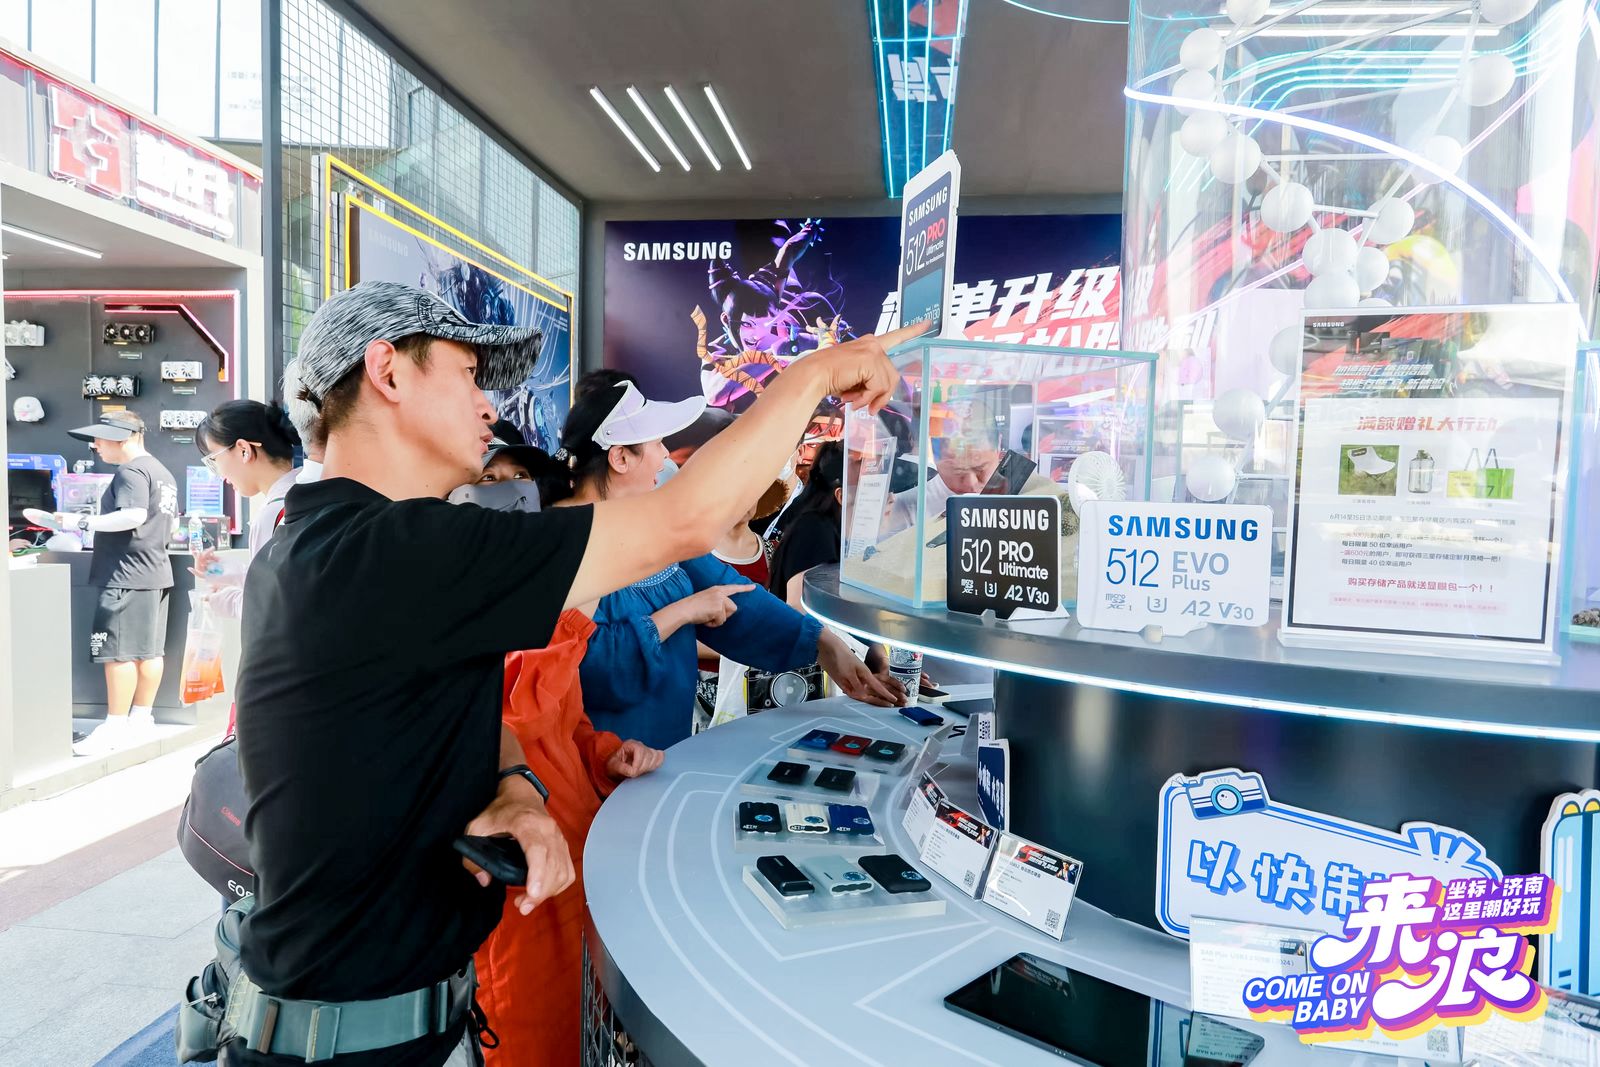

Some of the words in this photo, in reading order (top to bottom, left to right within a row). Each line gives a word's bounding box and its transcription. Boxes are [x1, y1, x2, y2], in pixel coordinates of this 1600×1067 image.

[908, 186, 948, 226] SAMSUNG
[623, 241, 732, 261] SAMSUNG
[905, 230, 927, 276] 512
[926, 217, 946, 244] PRO
[1357, 415, 1500, 431] 满额赠礼大行动
[960, 507, 1049, 531] SAMSUNG
[1108, 515, 1258, 541] SAMSUNG
[960, 538, 993, 575] 512
[999, 540, 1034, 563] PRO
[999, 562, 1049, 580] Ultimate
[1106, 548, 1160, 588] 512
[1173, 551, 1229, 575] EVO
[1172, 574, 1211, 591] Plus
[1004, 584, 1023, 601] A2
[1026, 586, 1050, 605] V30
[1181, 600, 1211, 617] A2
[1218, 602, 1254, 620] V30
